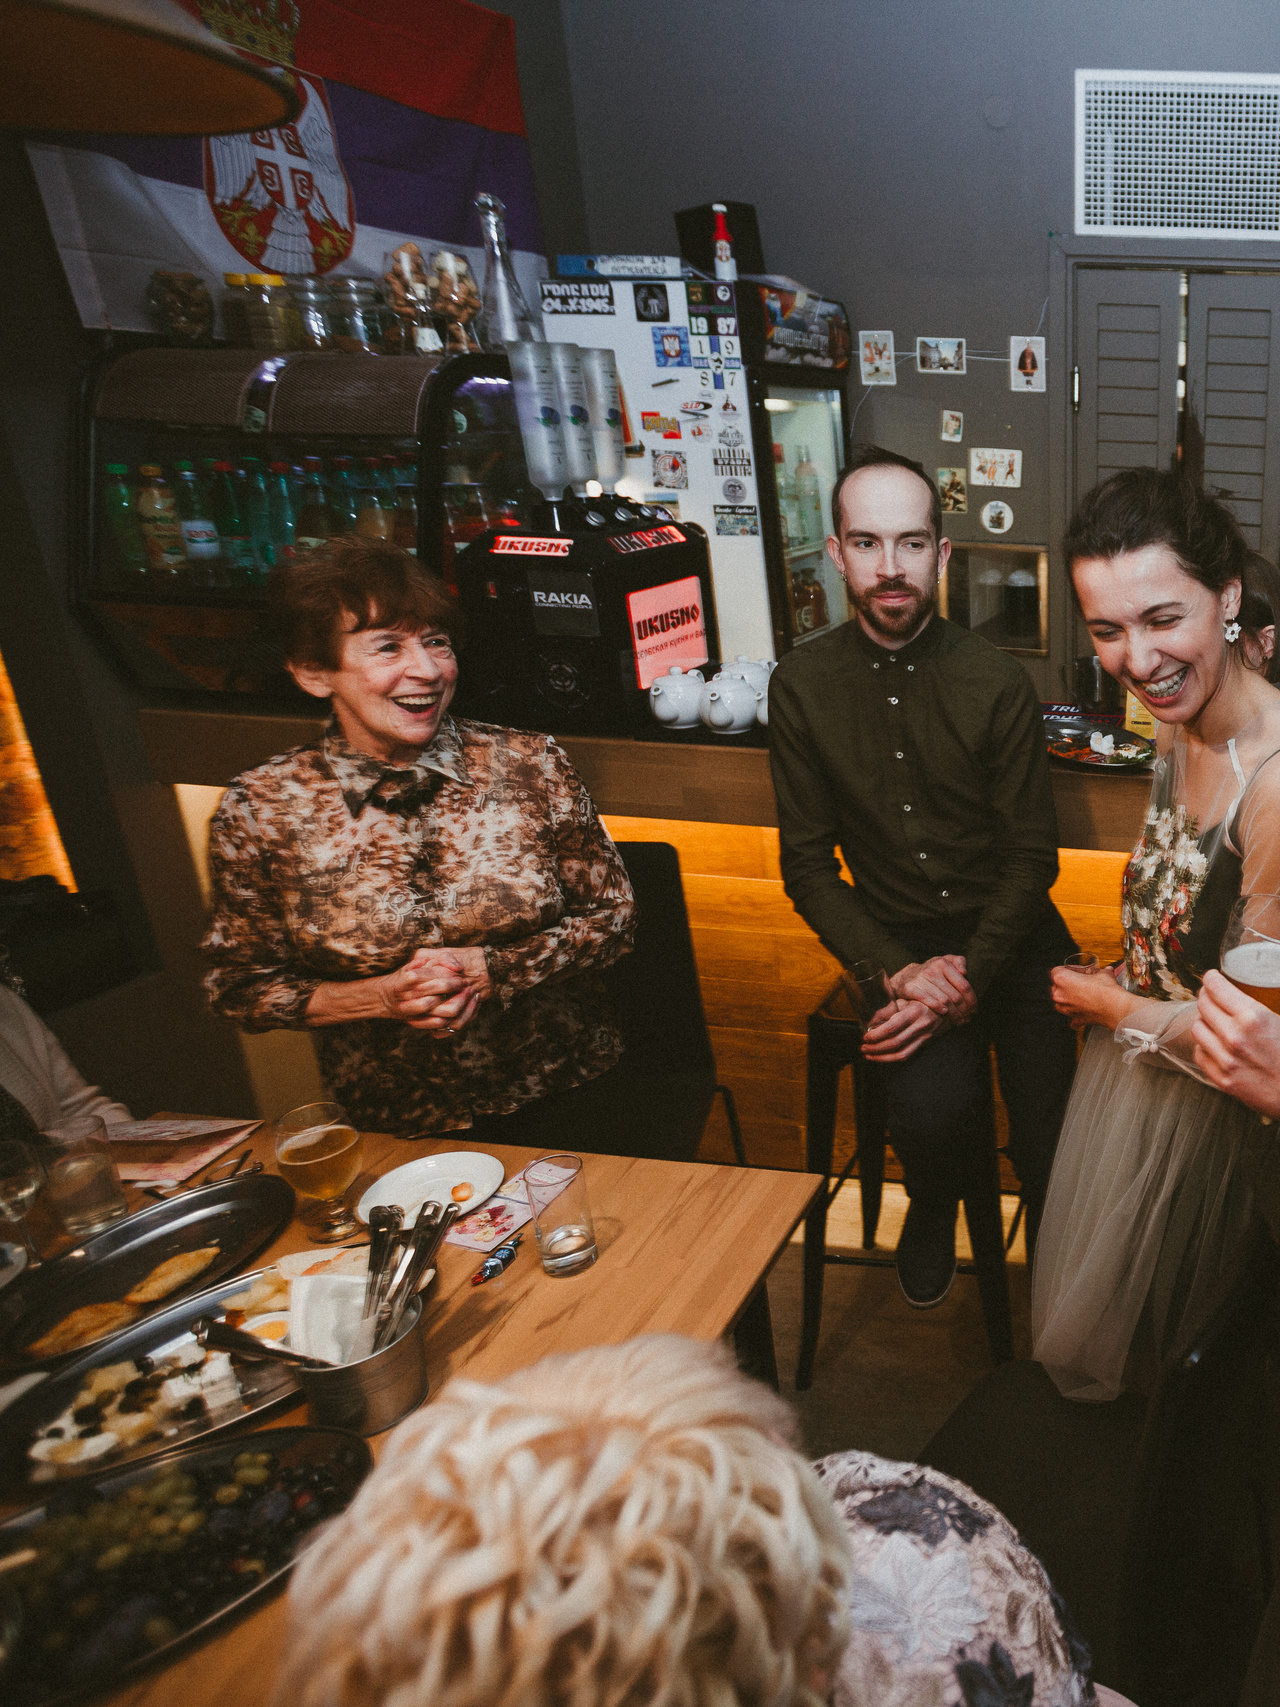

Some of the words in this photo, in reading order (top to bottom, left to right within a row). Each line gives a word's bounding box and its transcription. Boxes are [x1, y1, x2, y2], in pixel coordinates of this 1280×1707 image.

[691, 316, 708, 334] 19
[717, 316, 736, 334] 87
[533, 591, 592, 605] RAKIA
[636, 603, 700, 640] UKUSNO
